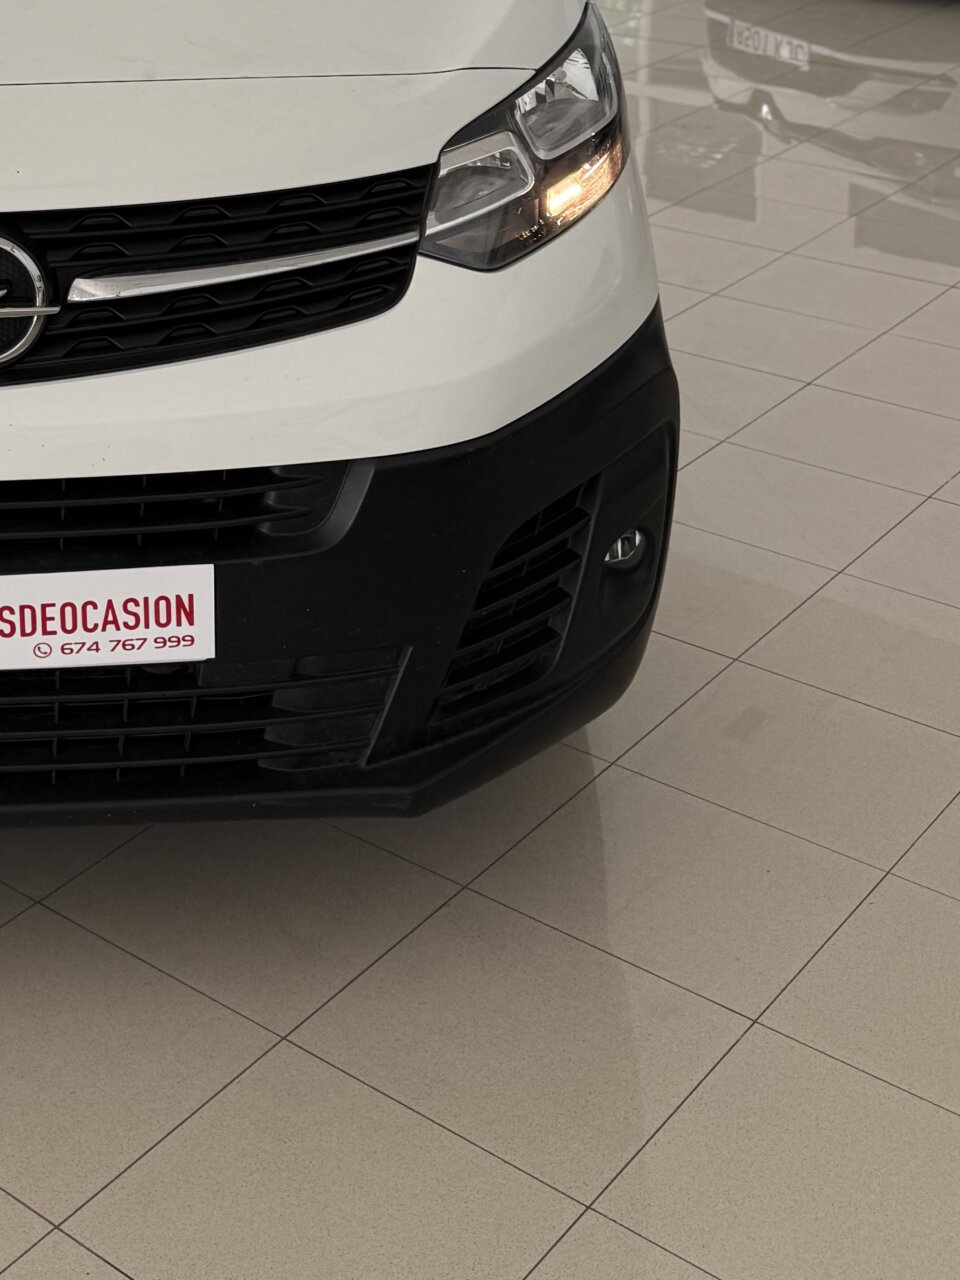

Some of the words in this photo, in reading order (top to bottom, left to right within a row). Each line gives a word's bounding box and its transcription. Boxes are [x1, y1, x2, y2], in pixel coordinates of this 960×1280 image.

[60, 641, 101, 655] 674
[109, 638, 147, 652] 767
[153, 634, 195, 649] 999
